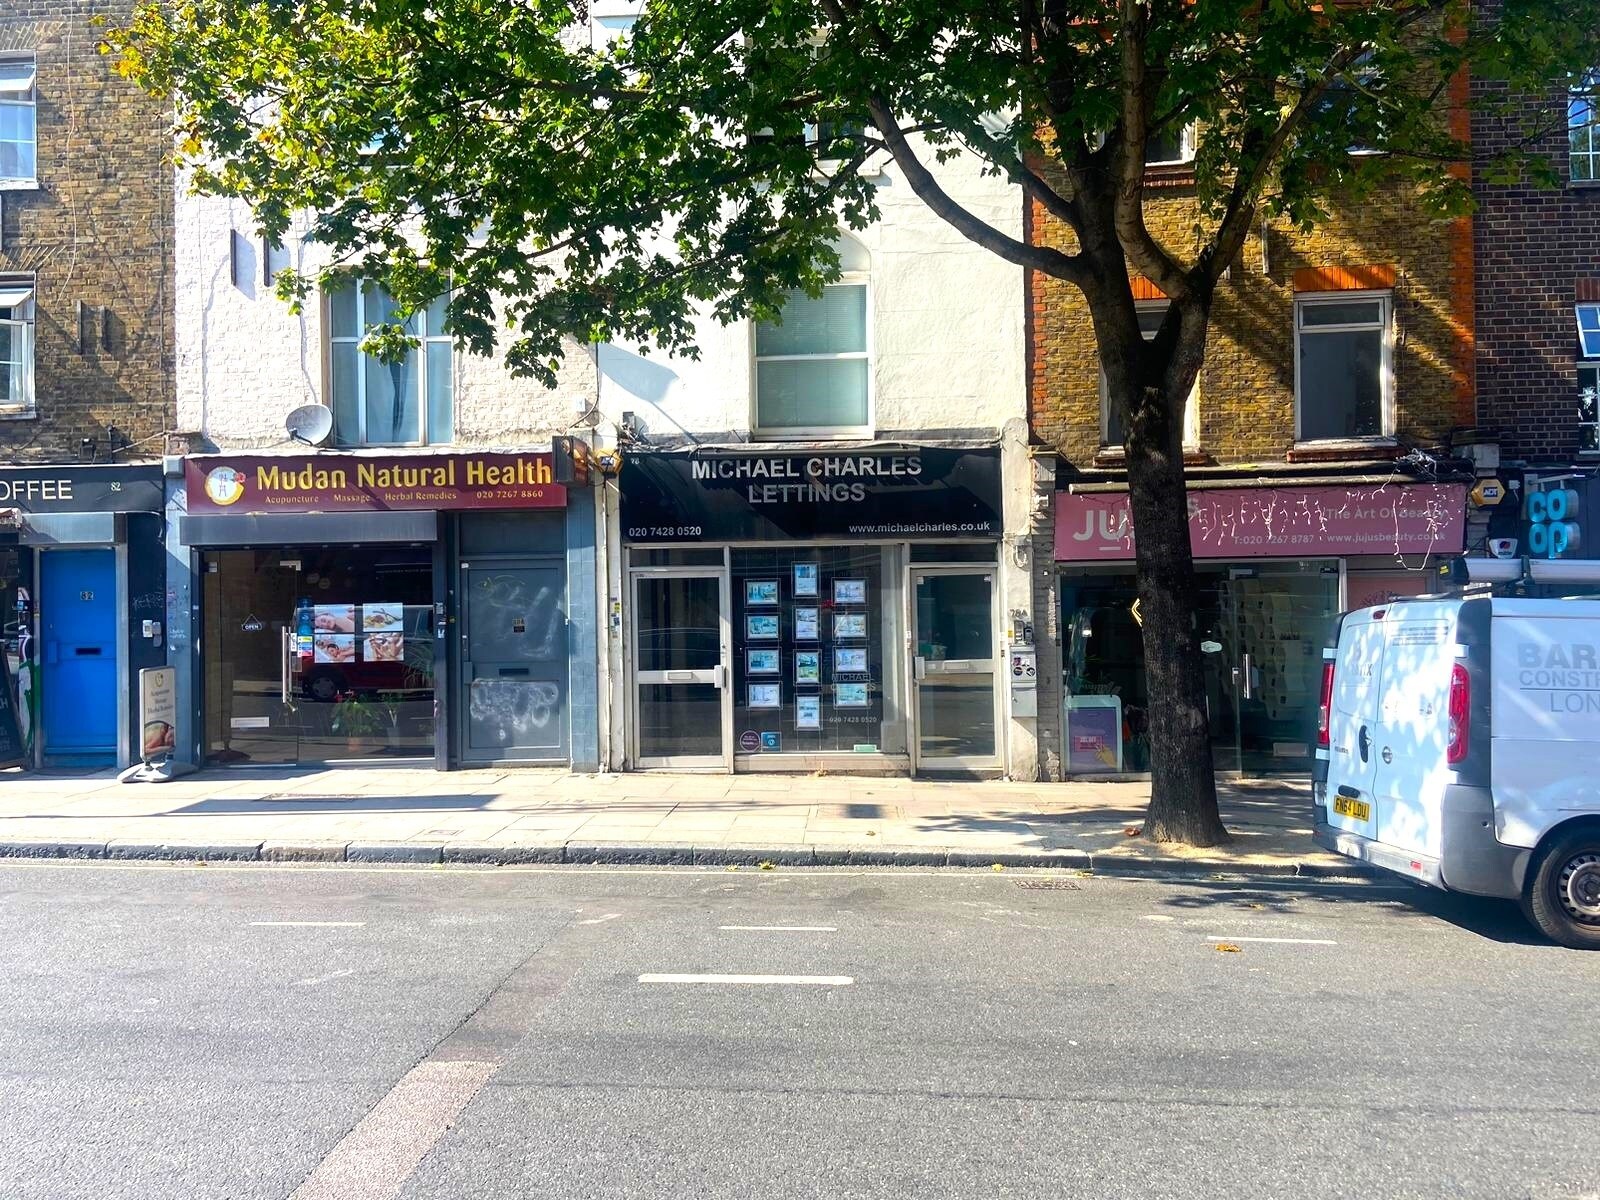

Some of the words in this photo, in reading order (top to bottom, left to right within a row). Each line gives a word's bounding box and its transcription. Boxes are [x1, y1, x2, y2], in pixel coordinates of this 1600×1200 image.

[257, 463, 346, 491] Mudan
[357, 459, 455, 488] Natural
[466, 457, 552, 486] Health
[692, 458, 800, 479] MICHAEL
[806, 456, 922, 477] CHARLES
[110, 482, 121, 492] 82
[748, 482, 866, 504] LETTINGS
[265, 494, 319, 505] Acupuncture
[333, 493, 371, 503] Massage
[385, 491, 414, 501] Herbal
[416, 490, 457, 500] Remedies
[476, 491, 494, 499] 020
[497, 490, 518, 498] 7267
[521, 489, 544, 498] 8860
[1326, 508, 1351, 520] The
[1354, 507, 1376, 519] Art
[628, 527, 647, 537] 020
[650, 526, 675, 536] 7428
[677, 526, 702, 536] 0520
[849, 521, 991, 534] www.michaelcharles.co.uk
[1291, 534, 1315, 544] 8787
[1518, 642, 1600, 669] BAR
